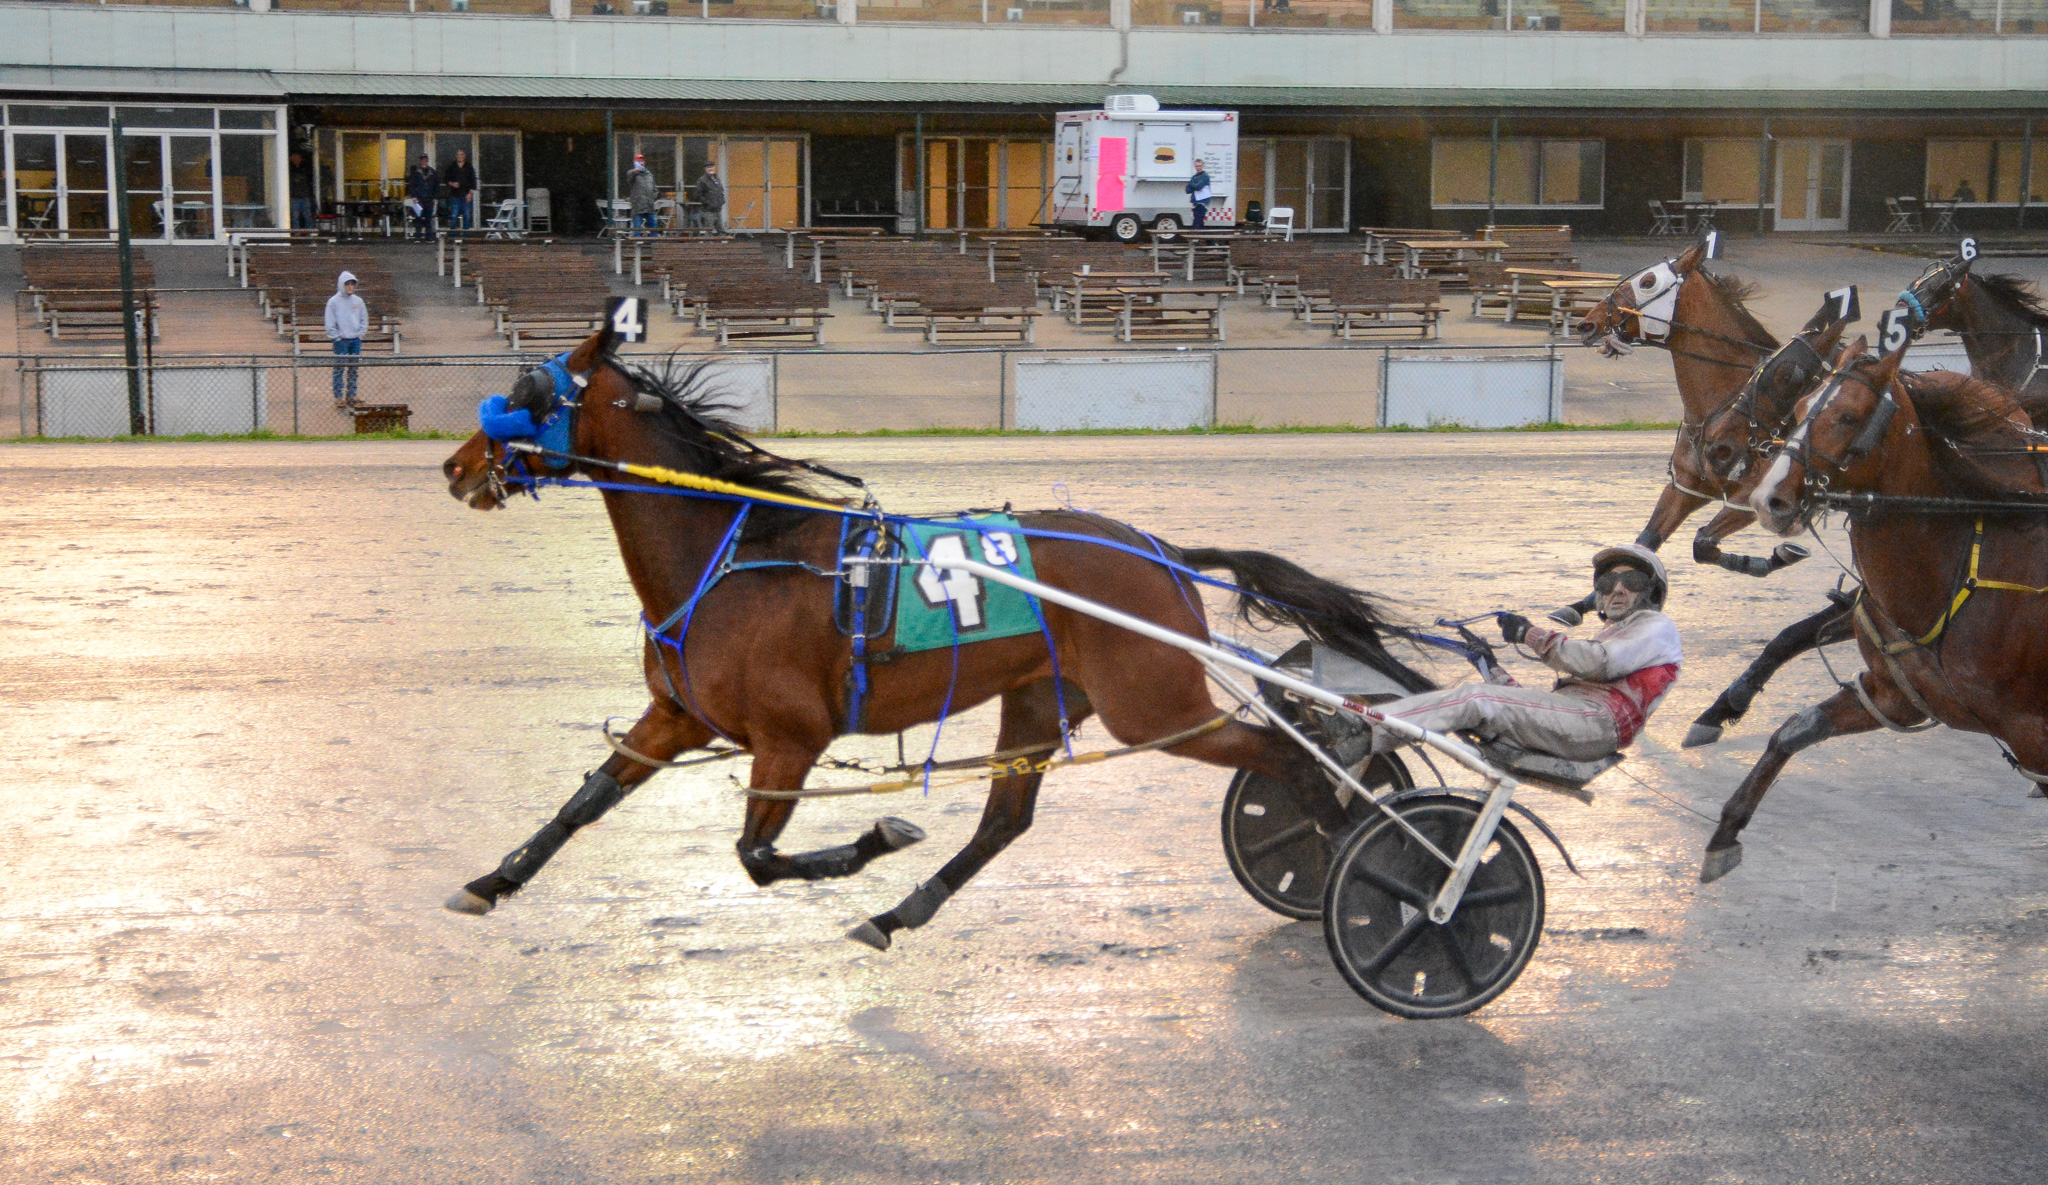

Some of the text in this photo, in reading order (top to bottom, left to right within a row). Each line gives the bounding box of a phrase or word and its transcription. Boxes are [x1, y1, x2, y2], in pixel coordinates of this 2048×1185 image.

[1706, 231, 1717, 258] 1
[1961, 238, 1977, 260] 6
[613, 298, 643, 342] 4
[1830, 287, 1851, 319] 7
[1884, 308, 1907, 351] 5
[980, 531, 1018, 566] 8
[916, 533, 983, 631] 4
